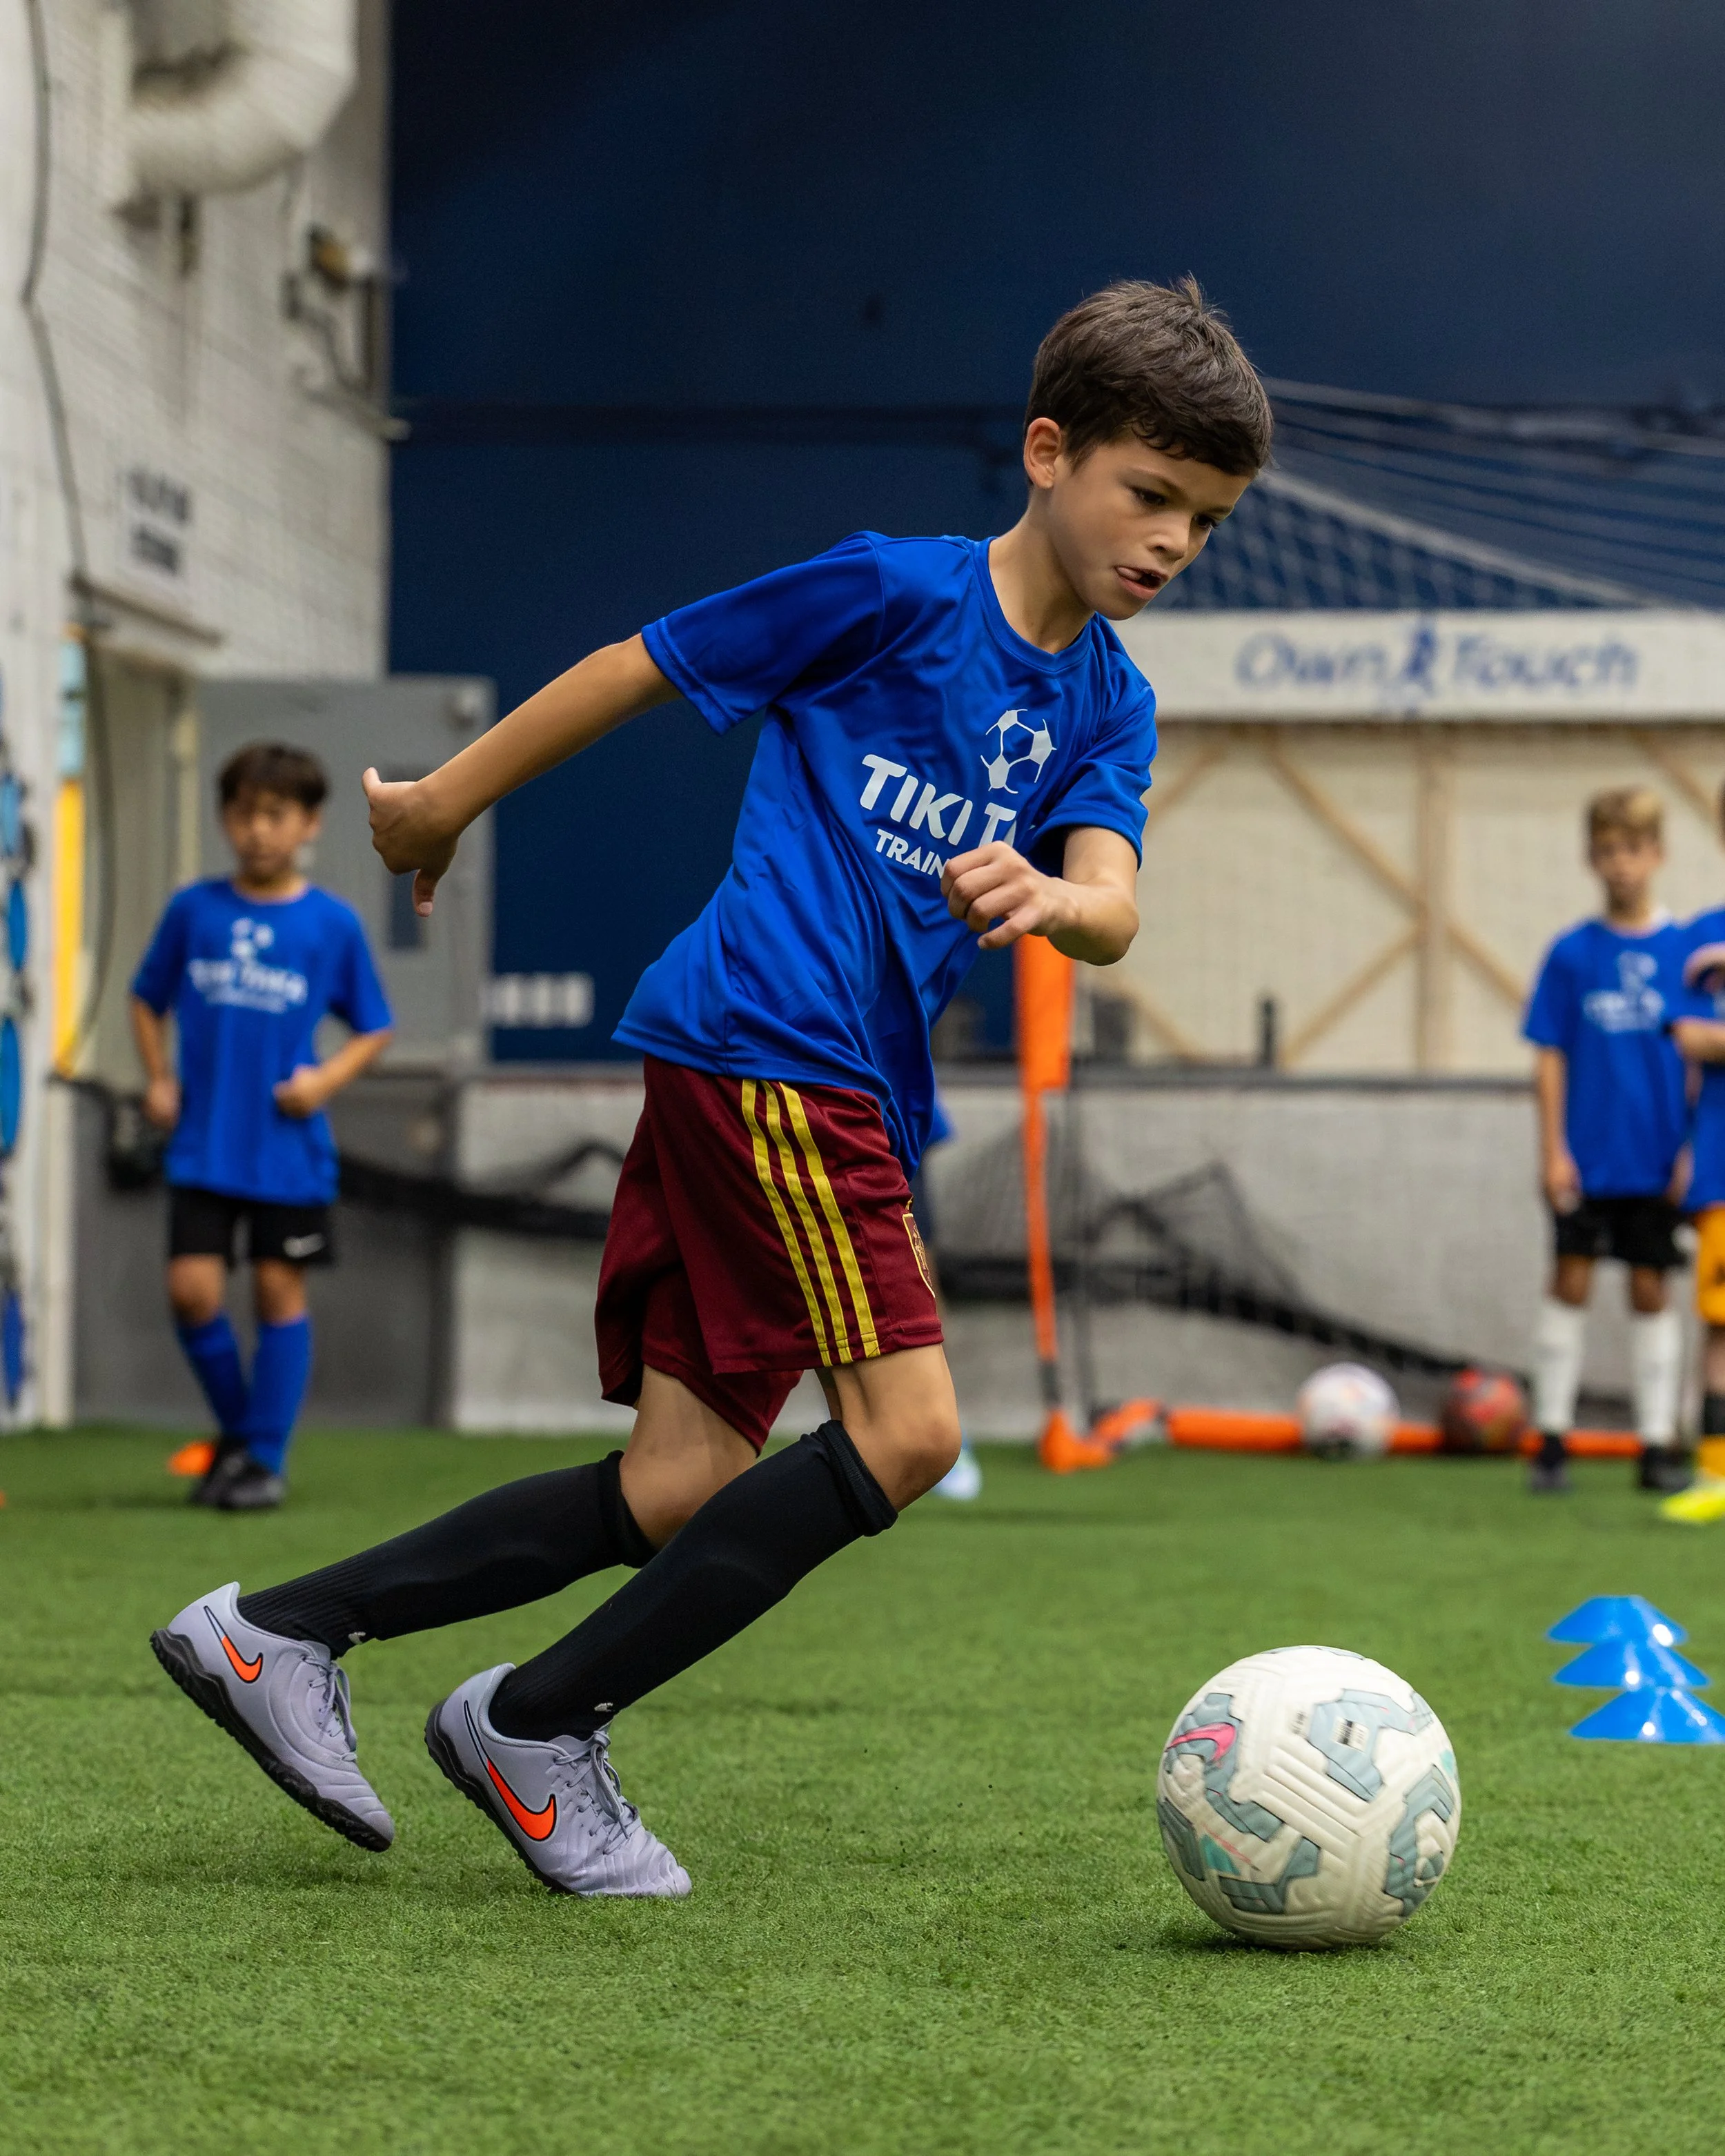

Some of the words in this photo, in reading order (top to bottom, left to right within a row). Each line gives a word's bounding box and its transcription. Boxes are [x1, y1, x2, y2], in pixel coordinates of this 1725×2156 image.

[1236, 631, 1383, 686] Own
[1454, 631, 1638, 687] Touch
[860, 754, 973, 846] TIKI
